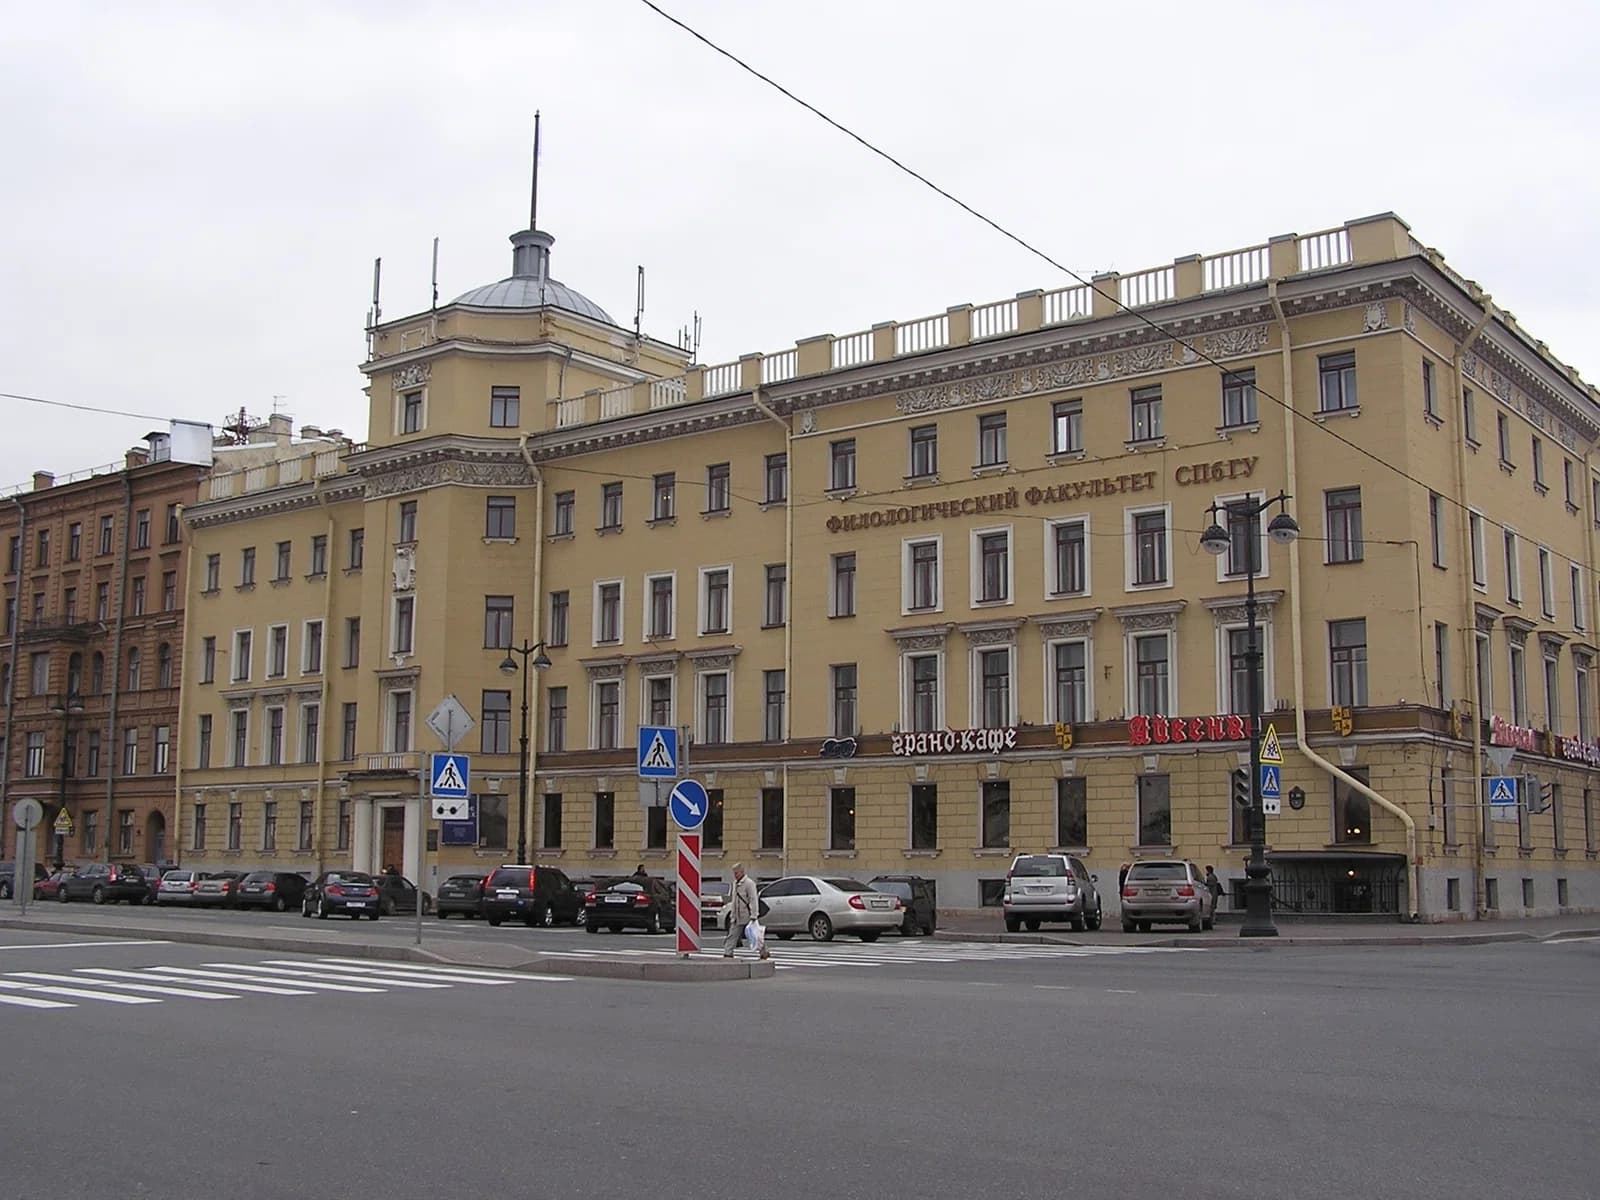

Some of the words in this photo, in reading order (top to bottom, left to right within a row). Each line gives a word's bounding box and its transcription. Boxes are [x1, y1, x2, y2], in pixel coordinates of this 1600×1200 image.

[826, 486, 1020, 534] ФИЛОЛОГИЧЕСКИЙ
[1024, 471, 1158, 506] ФАКУЛЬТЕТ
[1174, 456, 1260, 487] СПбГУ
